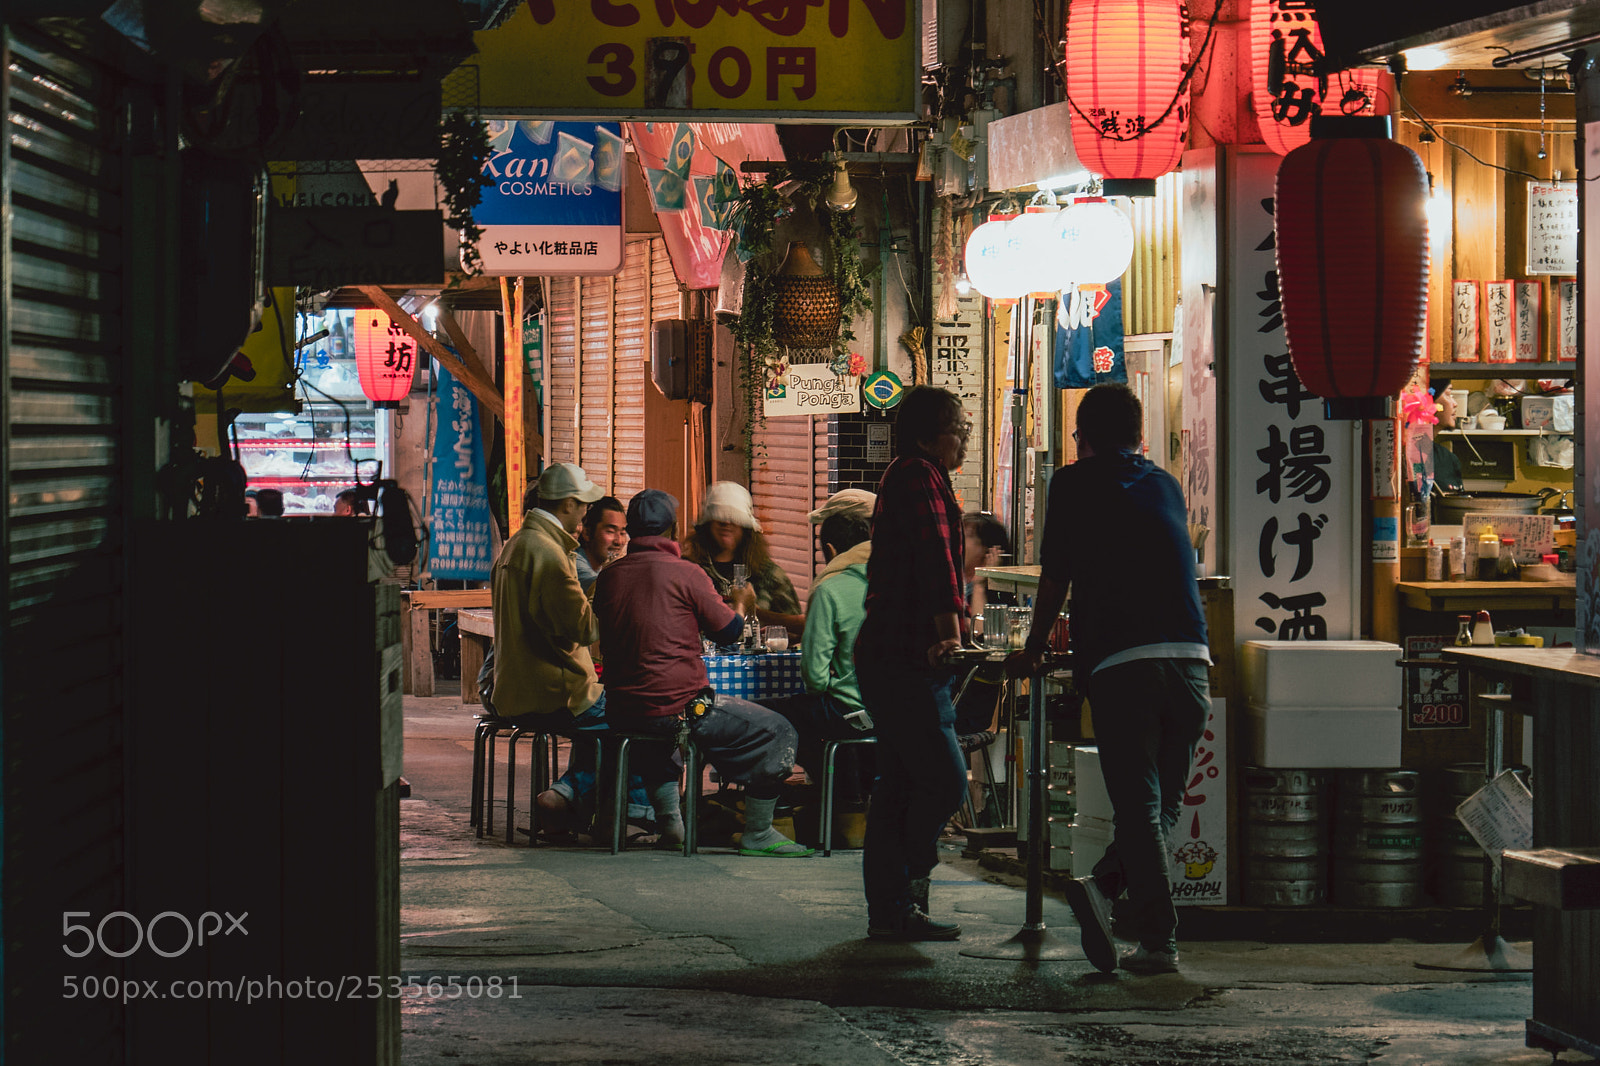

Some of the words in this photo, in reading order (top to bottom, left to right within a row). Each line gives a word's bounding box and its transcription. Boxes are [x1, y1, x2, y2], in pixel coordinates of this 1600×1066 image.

[500, 182, 592, 195] COSMETICS
[304, 219, 394, 249] 入口
[494, 241, 598, 255] やよい化粧品店
[1490, 286, 1507, 346] 抹茶ビール
[790, 374, 846, 394] Punga
[797, 391, 855, 409] Ponga
[1413, 704, 1463, 724] ¥200
